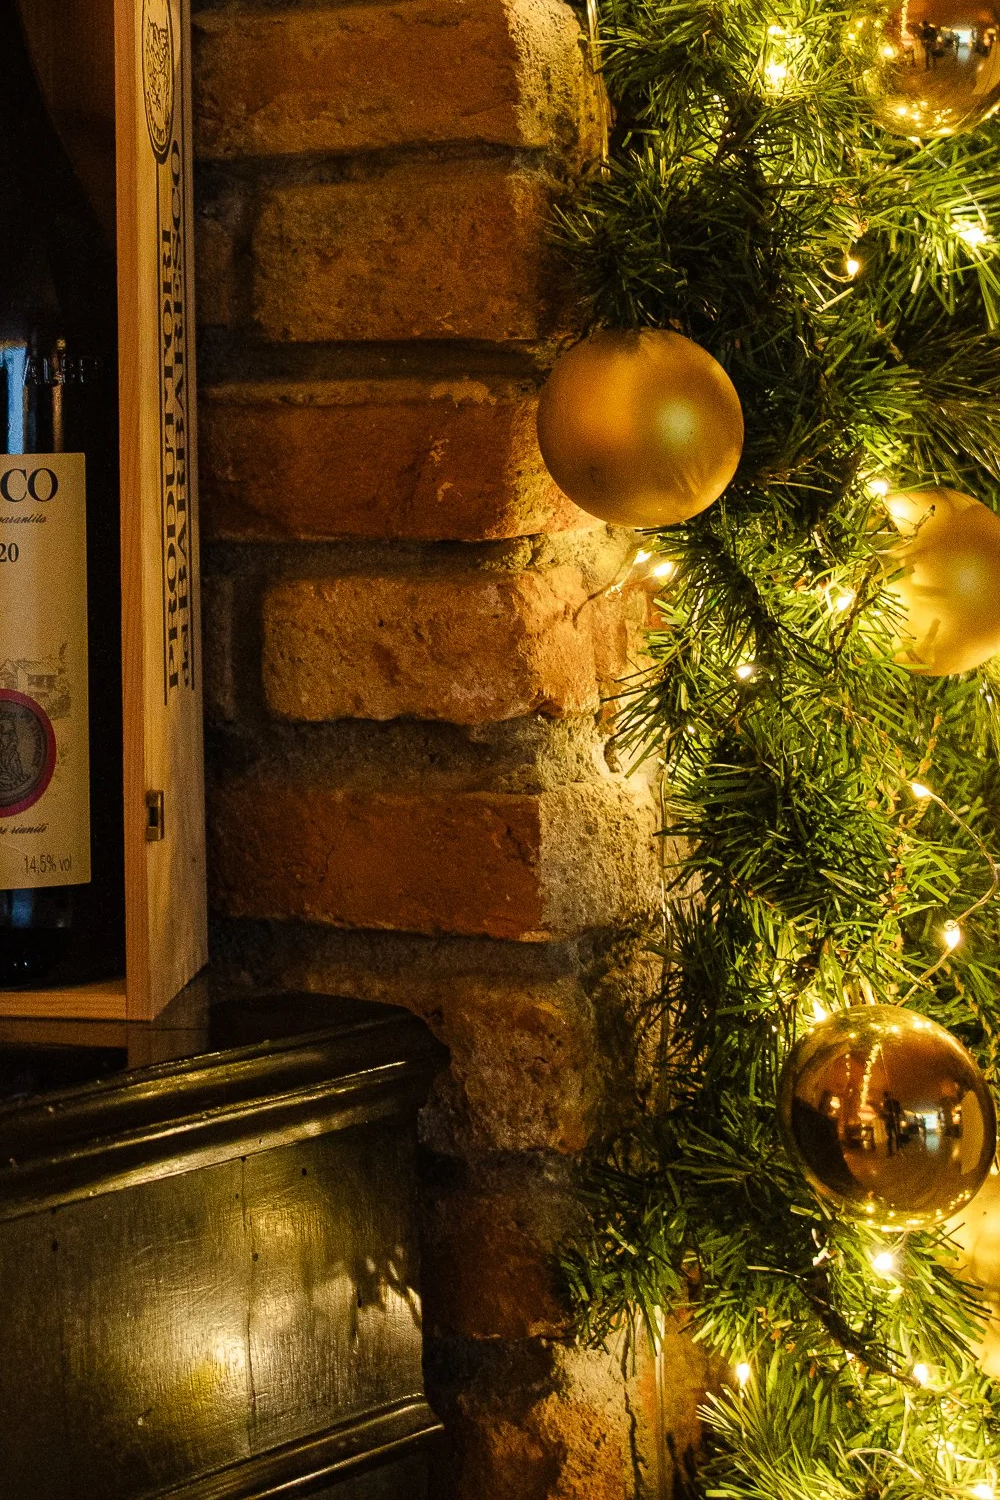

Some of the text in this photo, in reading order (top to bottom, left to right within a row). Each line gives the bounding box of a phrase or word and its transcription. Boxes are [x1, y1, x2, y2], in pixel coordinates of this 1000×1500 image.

[162, 223, 179, 694] PRODUTTORI
[171, 140, 189, 611] BARBARESCO
[11, 822, 48, 835] riuniti
[24, 854, 72, 874] 14,5% vol
